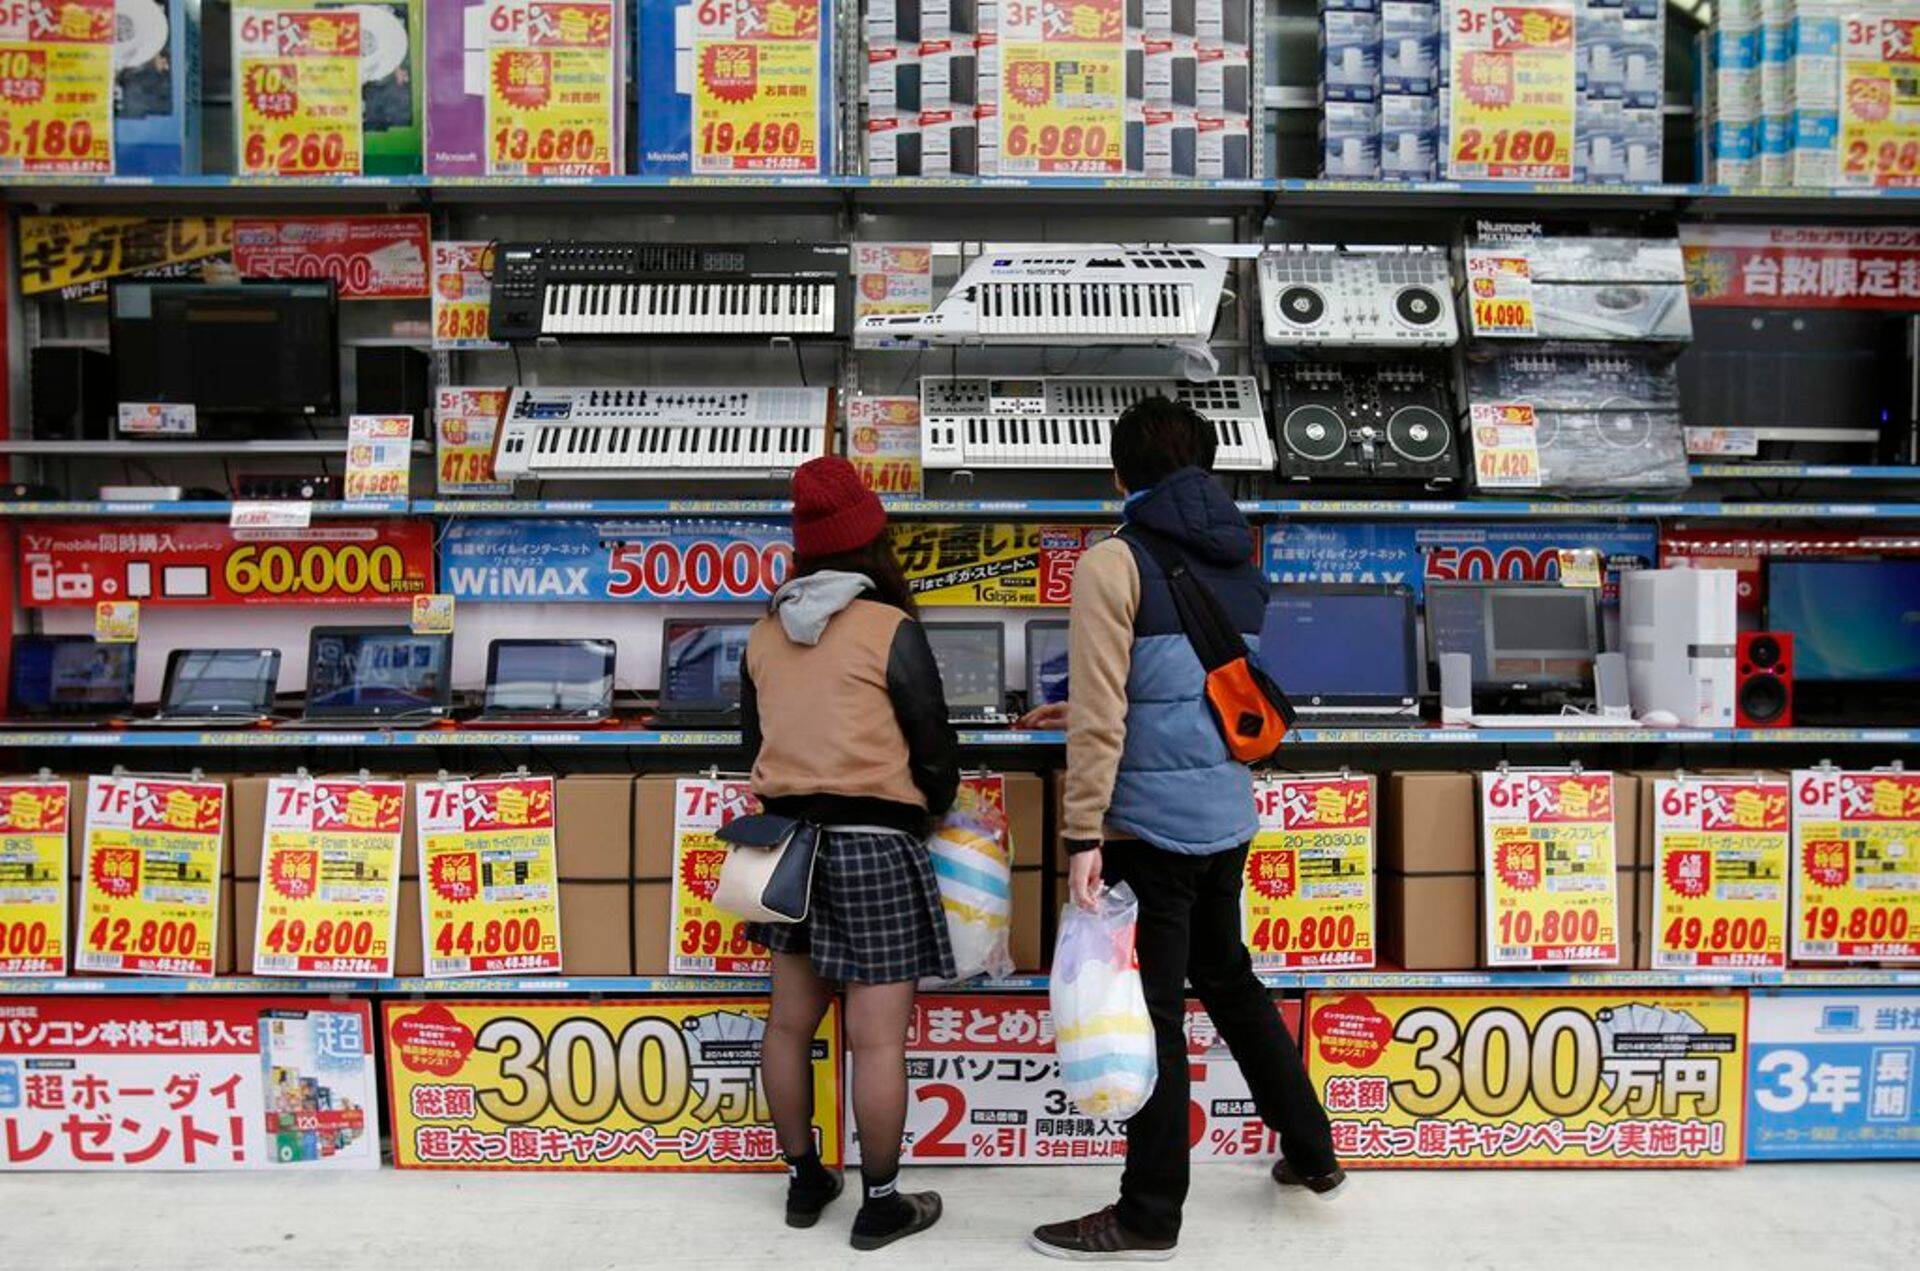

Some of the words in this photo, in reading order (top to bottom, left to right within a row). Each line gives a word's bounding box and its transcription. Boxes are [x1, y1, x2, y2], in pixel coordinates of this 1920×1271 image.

[490, 5, 525, 32] 6F
[697, 0, 733, 26] 6F
[1006, 3, 1038, 26] 3F
[1457, 9, 1487, 33] 3F
[241, 16, 275, 43] 6F
[1847, 21, 1878, 46] 3F
[495, 128, 609, 160] 13,680円
[702, 121, 814, 154] 19,480円
[1007, 125, 1120, 157] 6,980円
[1456, 129, 1569, 162] 2,180円
[435, 152, 478, 162] Microsoft
[647, 152, 689, 162] Microsoft
[1477, 221, 1542, 234] Numark
[225, 544, 404, 594] 60,000
[449, 566, 590, 596] WiMAX
[97, 785, 130, 813] 7F
[276, 786, 309, 816] 7F
[424, 787, 460, 819] 7F
[684, 786, 719, 816] 7F
[1489, 779, 1525, 808] 6F
[1662, 788, 1698, 816] 6F
[1799, 777, 1835, 806] 6F
[89, 916, 211, 956] 42,800円
[266, 917, 388, 955] 49,800円
[435, 917, 557, 956] 44,800円
[681, 919, 767, 955] 39,8
[1252, 914, 1370, 952] 40,800円
[1499, 909, 1613, 945] 10,800円
[1664, 917, 1781, 950] 49,800円
[411, 1089, 475, 1118] 総額
[476, 1016, 774, 1123] 300万
[1754, 1049, 1862, 1114] 3年
[25, 1074, 245, 1111] 超ホーダイ
[1327, 1079, 1389, 1108] 総額
[417, 1127, 821, 1161] 超太っ腹キャンペーン実施
[1331, 1120, 1722, 1155] 超太っ腹キャンペーン実施中!
